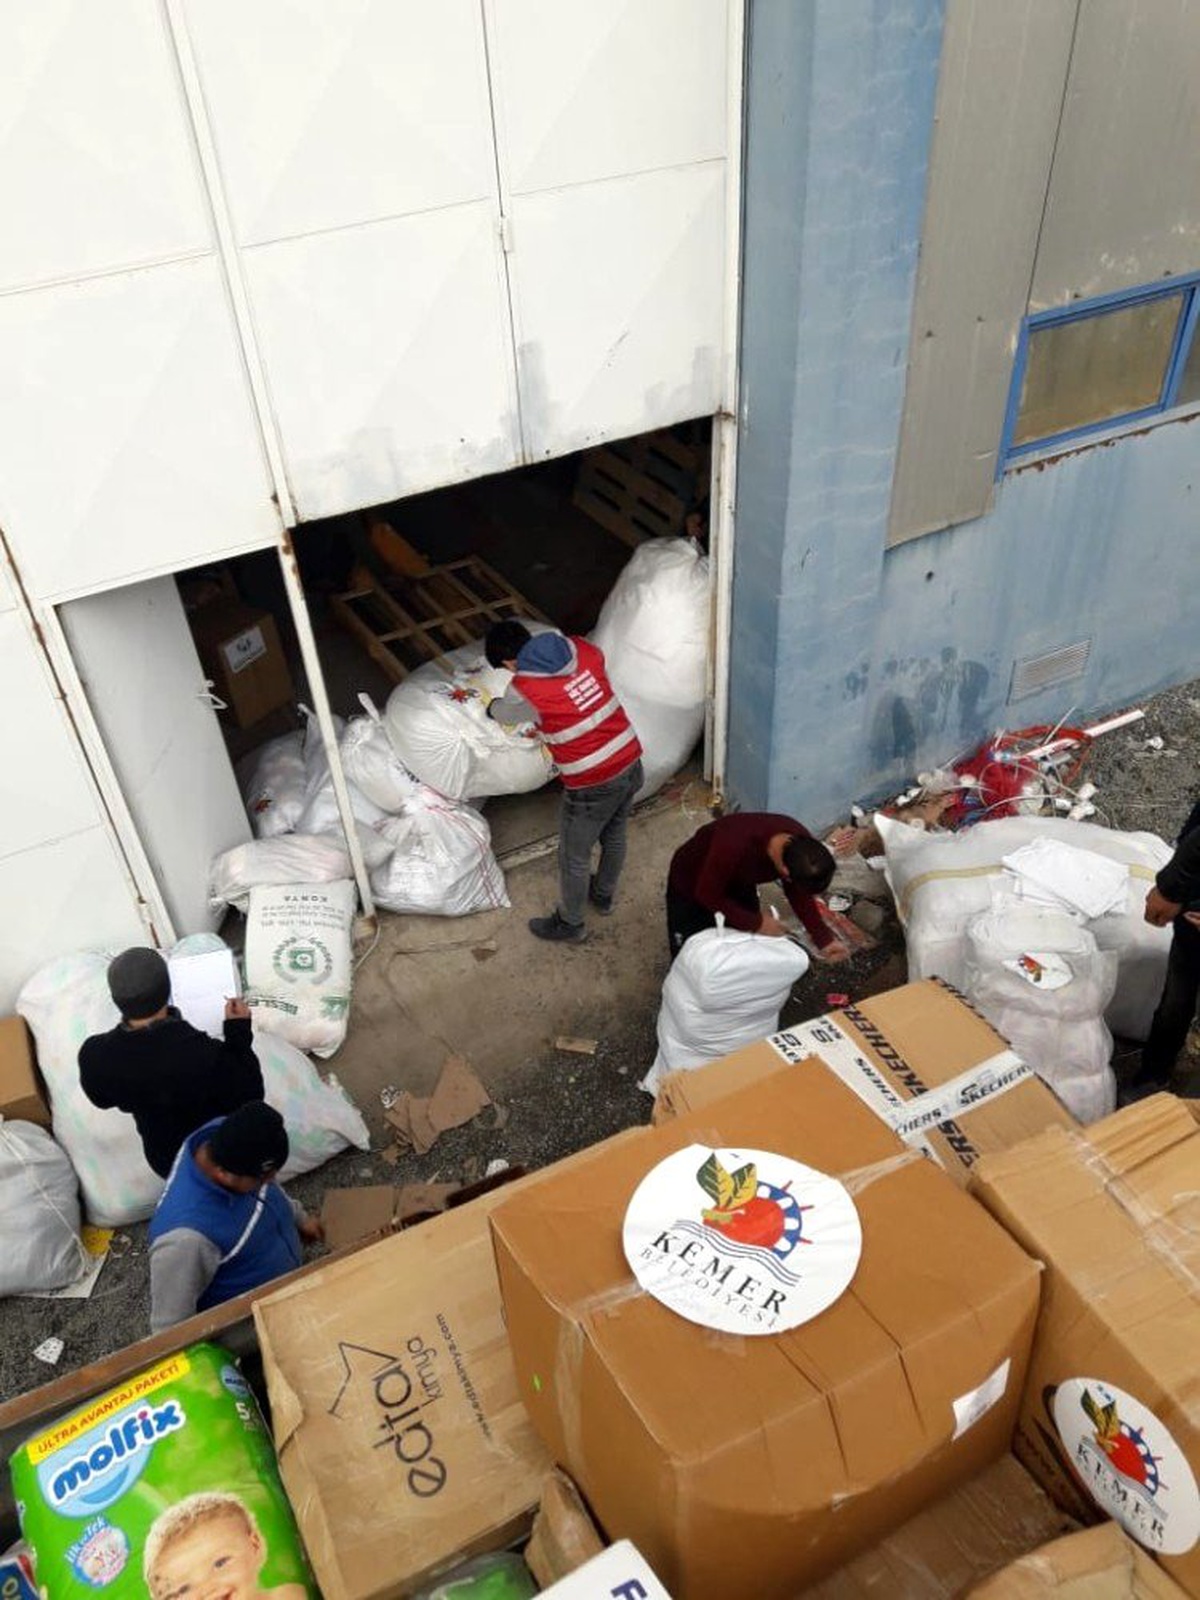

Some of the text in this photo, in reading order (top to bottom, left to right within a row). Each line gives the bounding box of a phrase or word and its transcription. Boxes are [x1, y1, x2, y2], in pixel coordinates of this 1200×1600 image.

[650, 1231, 787, 1314] KEMER
[38, 1424, 78, 1454] ULTRA
[80, 1388, 134, 1428] AVANTAJ
[53, 1402, 182, 1501] molfix
[1077, 1445, 1165, 1539] KEMER
